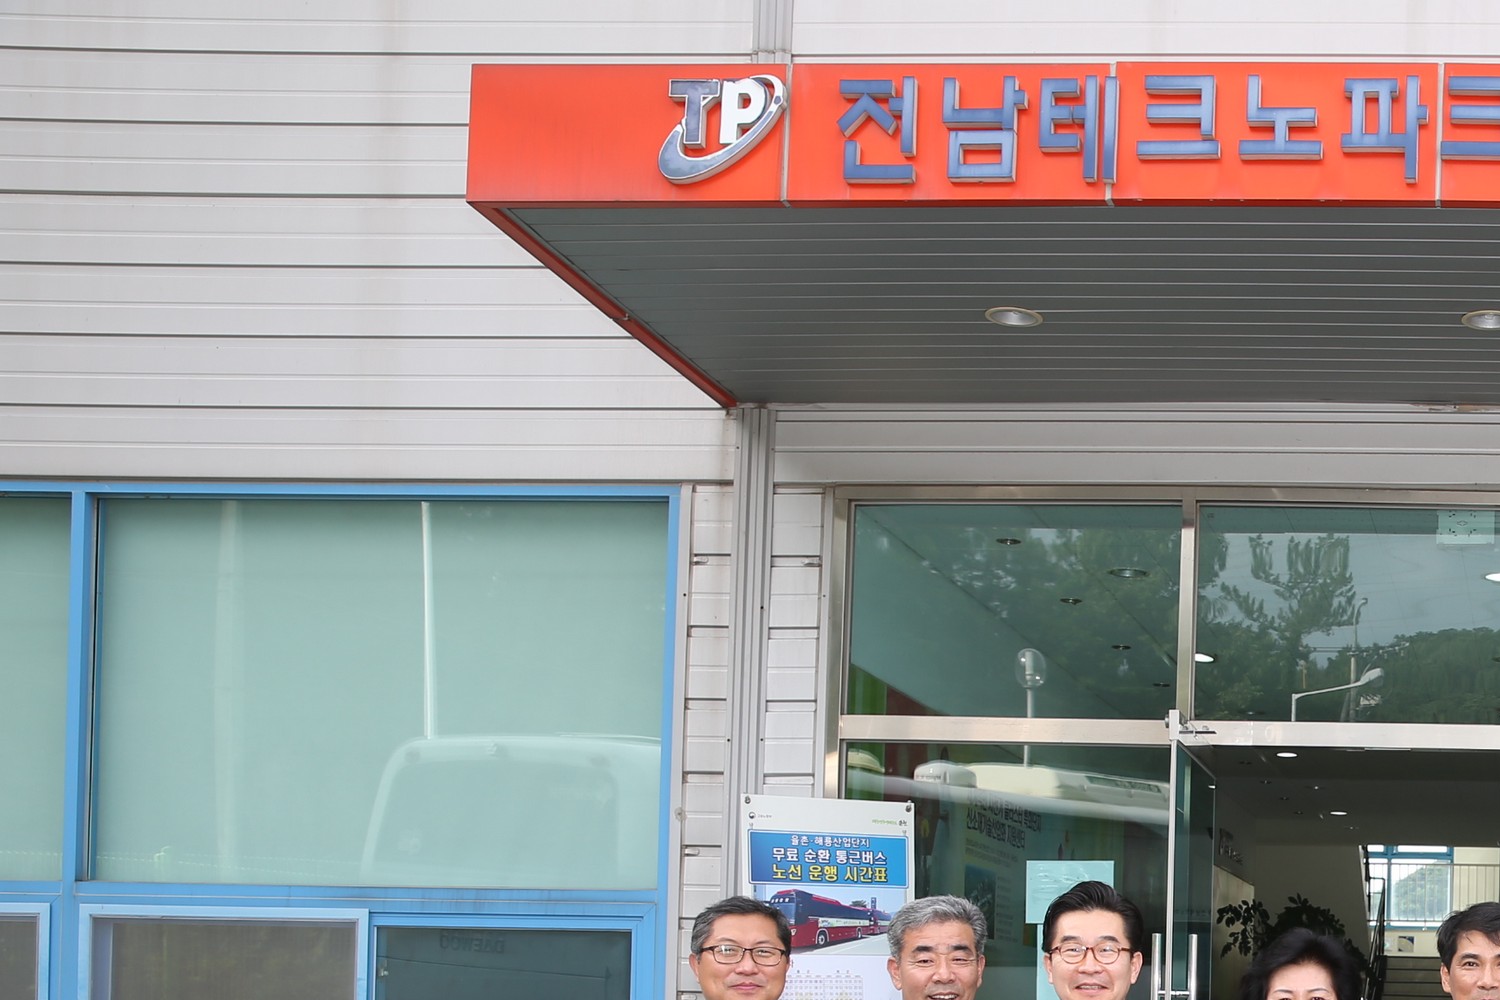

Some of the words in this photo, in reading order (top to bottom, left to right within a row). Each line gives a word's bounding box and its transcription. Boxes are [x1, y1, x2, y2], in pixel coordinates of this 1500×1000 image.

[772, 847, 799, 862] 무료
[804, 849, 830, 864] 순환
[835, 850, 887, 865] 통근버스
[772, 864, 802, 880] 노선
[808, 865, 838, 882] 운행
[844, 866, 888, 883] 시간표
